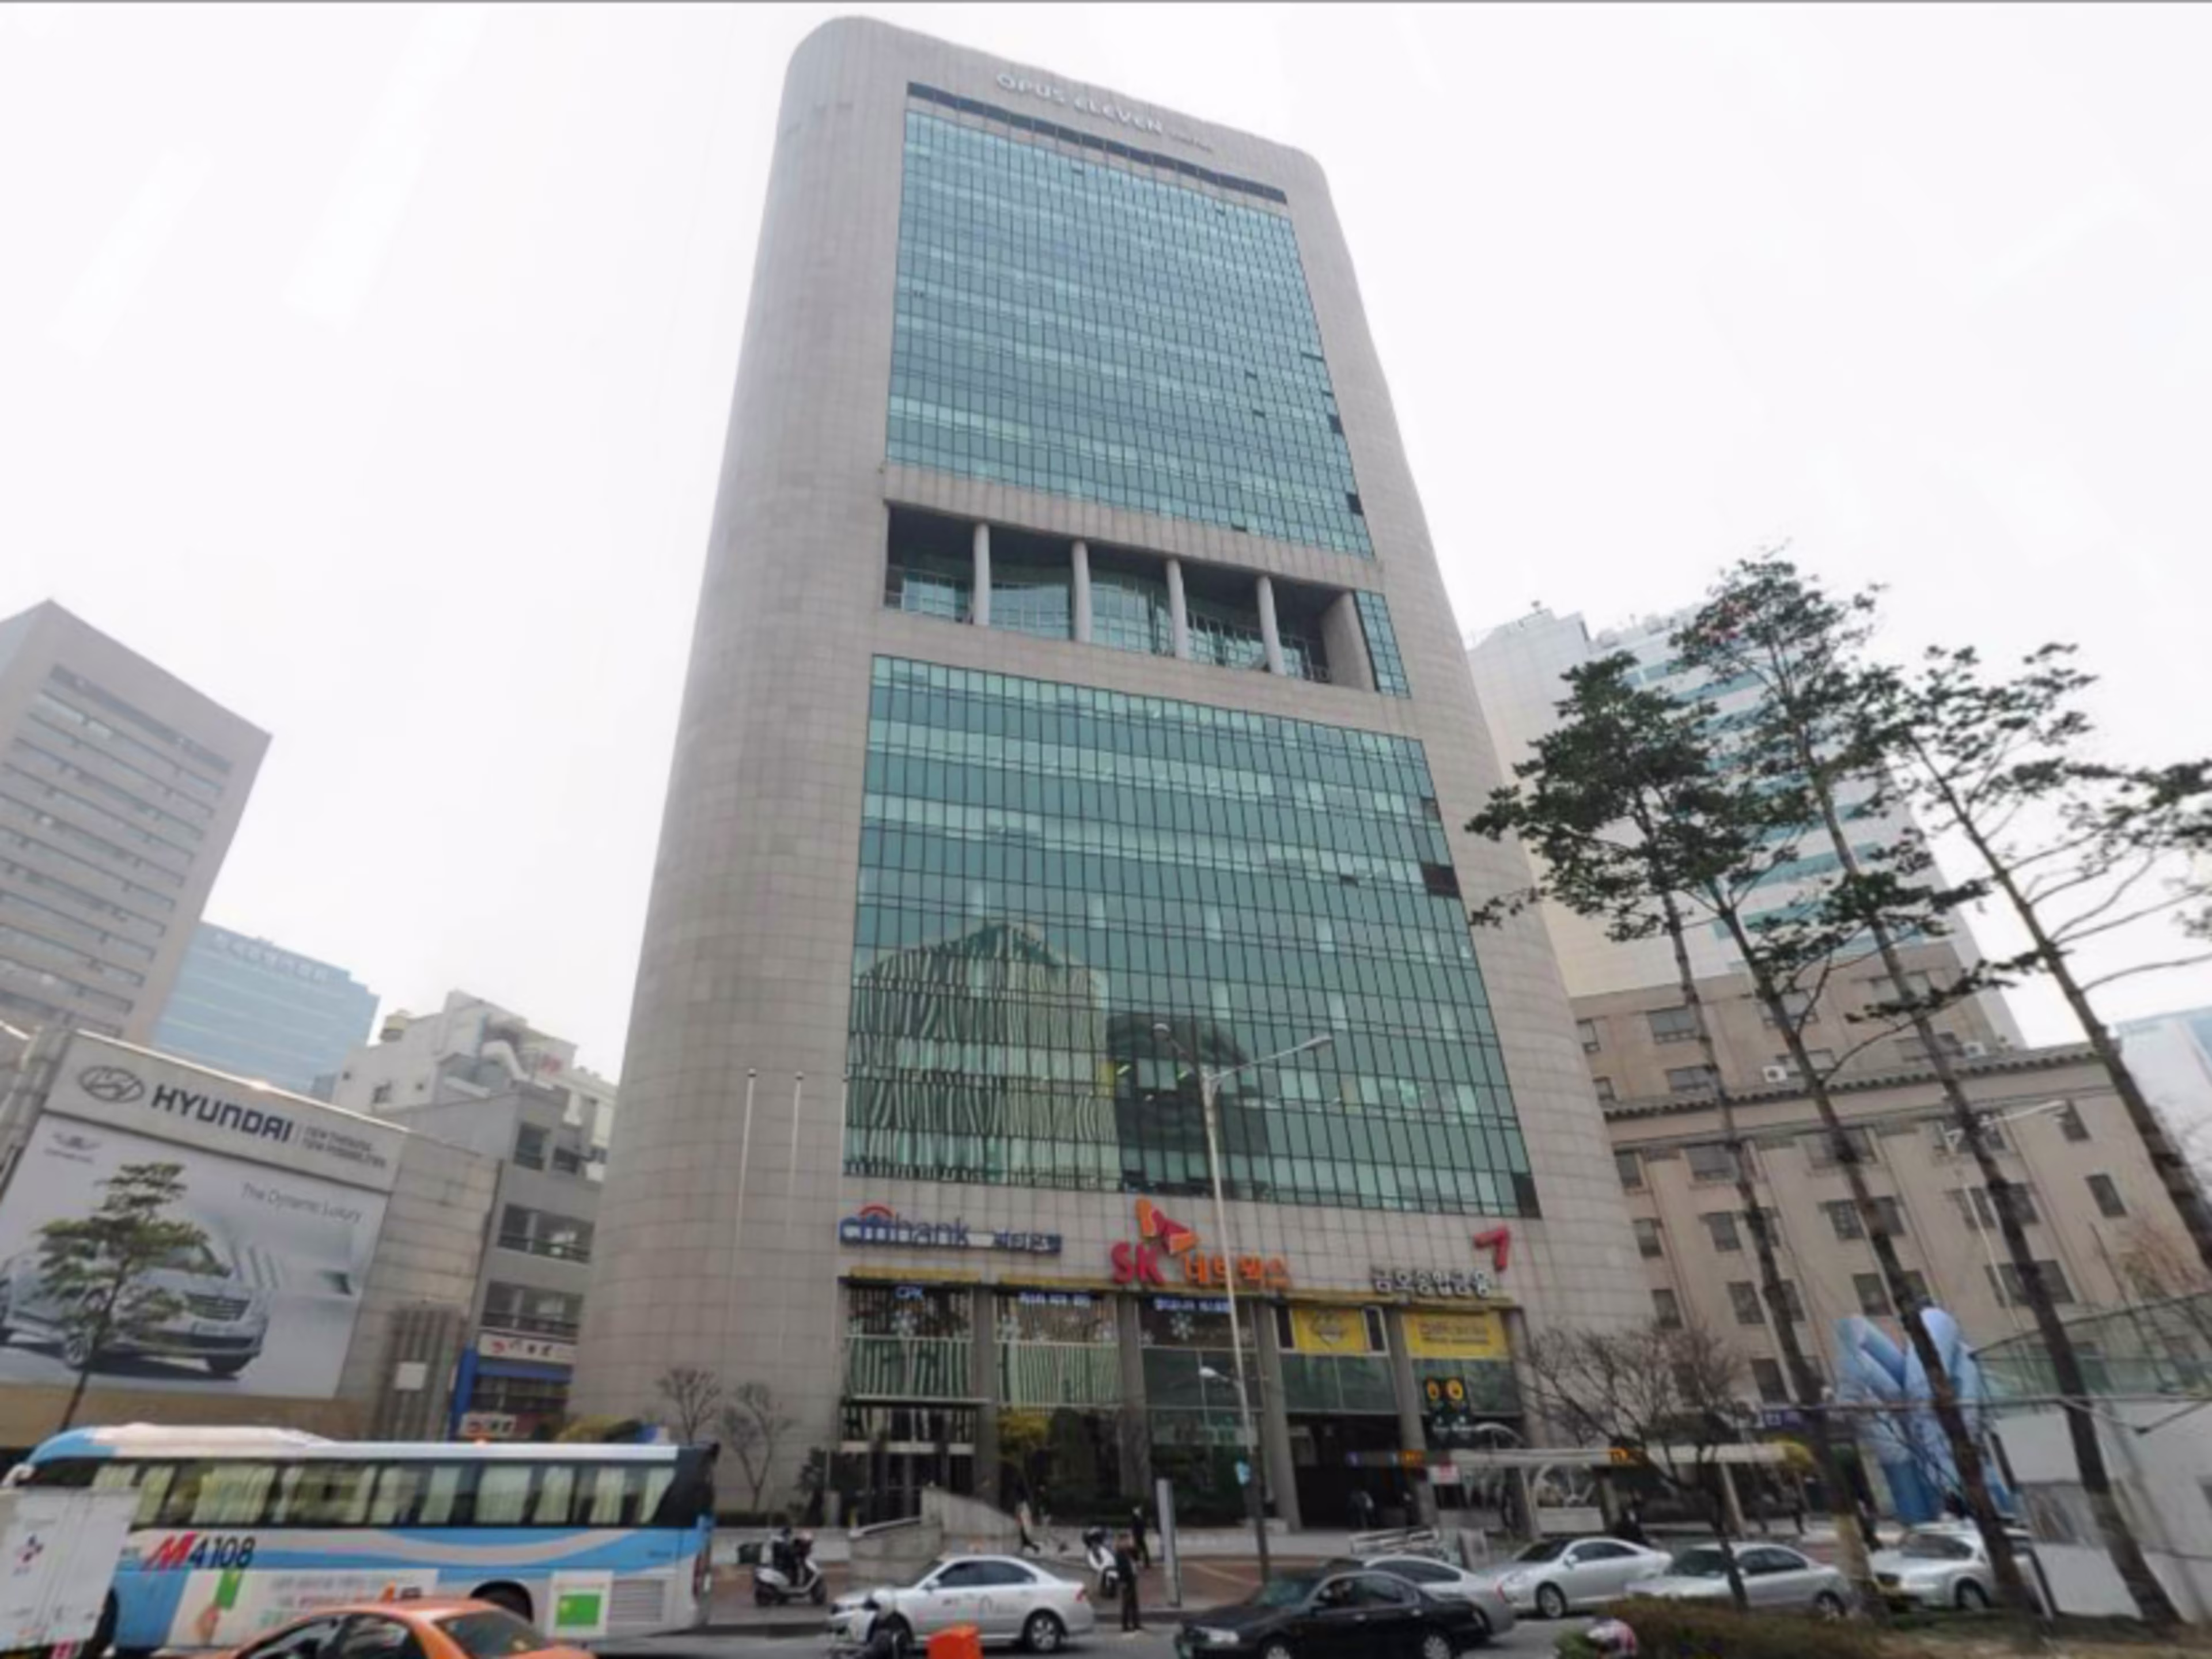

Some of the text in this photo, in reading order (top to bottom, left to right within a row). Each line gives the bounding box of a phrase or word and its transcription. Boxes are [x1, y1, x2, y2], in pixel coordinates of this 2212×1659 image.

[996, 73, 1067, 104] OPUS
[150, 1083, 294, 1143] HYUNDAI
[1111, 1241, 1167, 1286] SK
[143, 1531, 256, 1571] M4108
